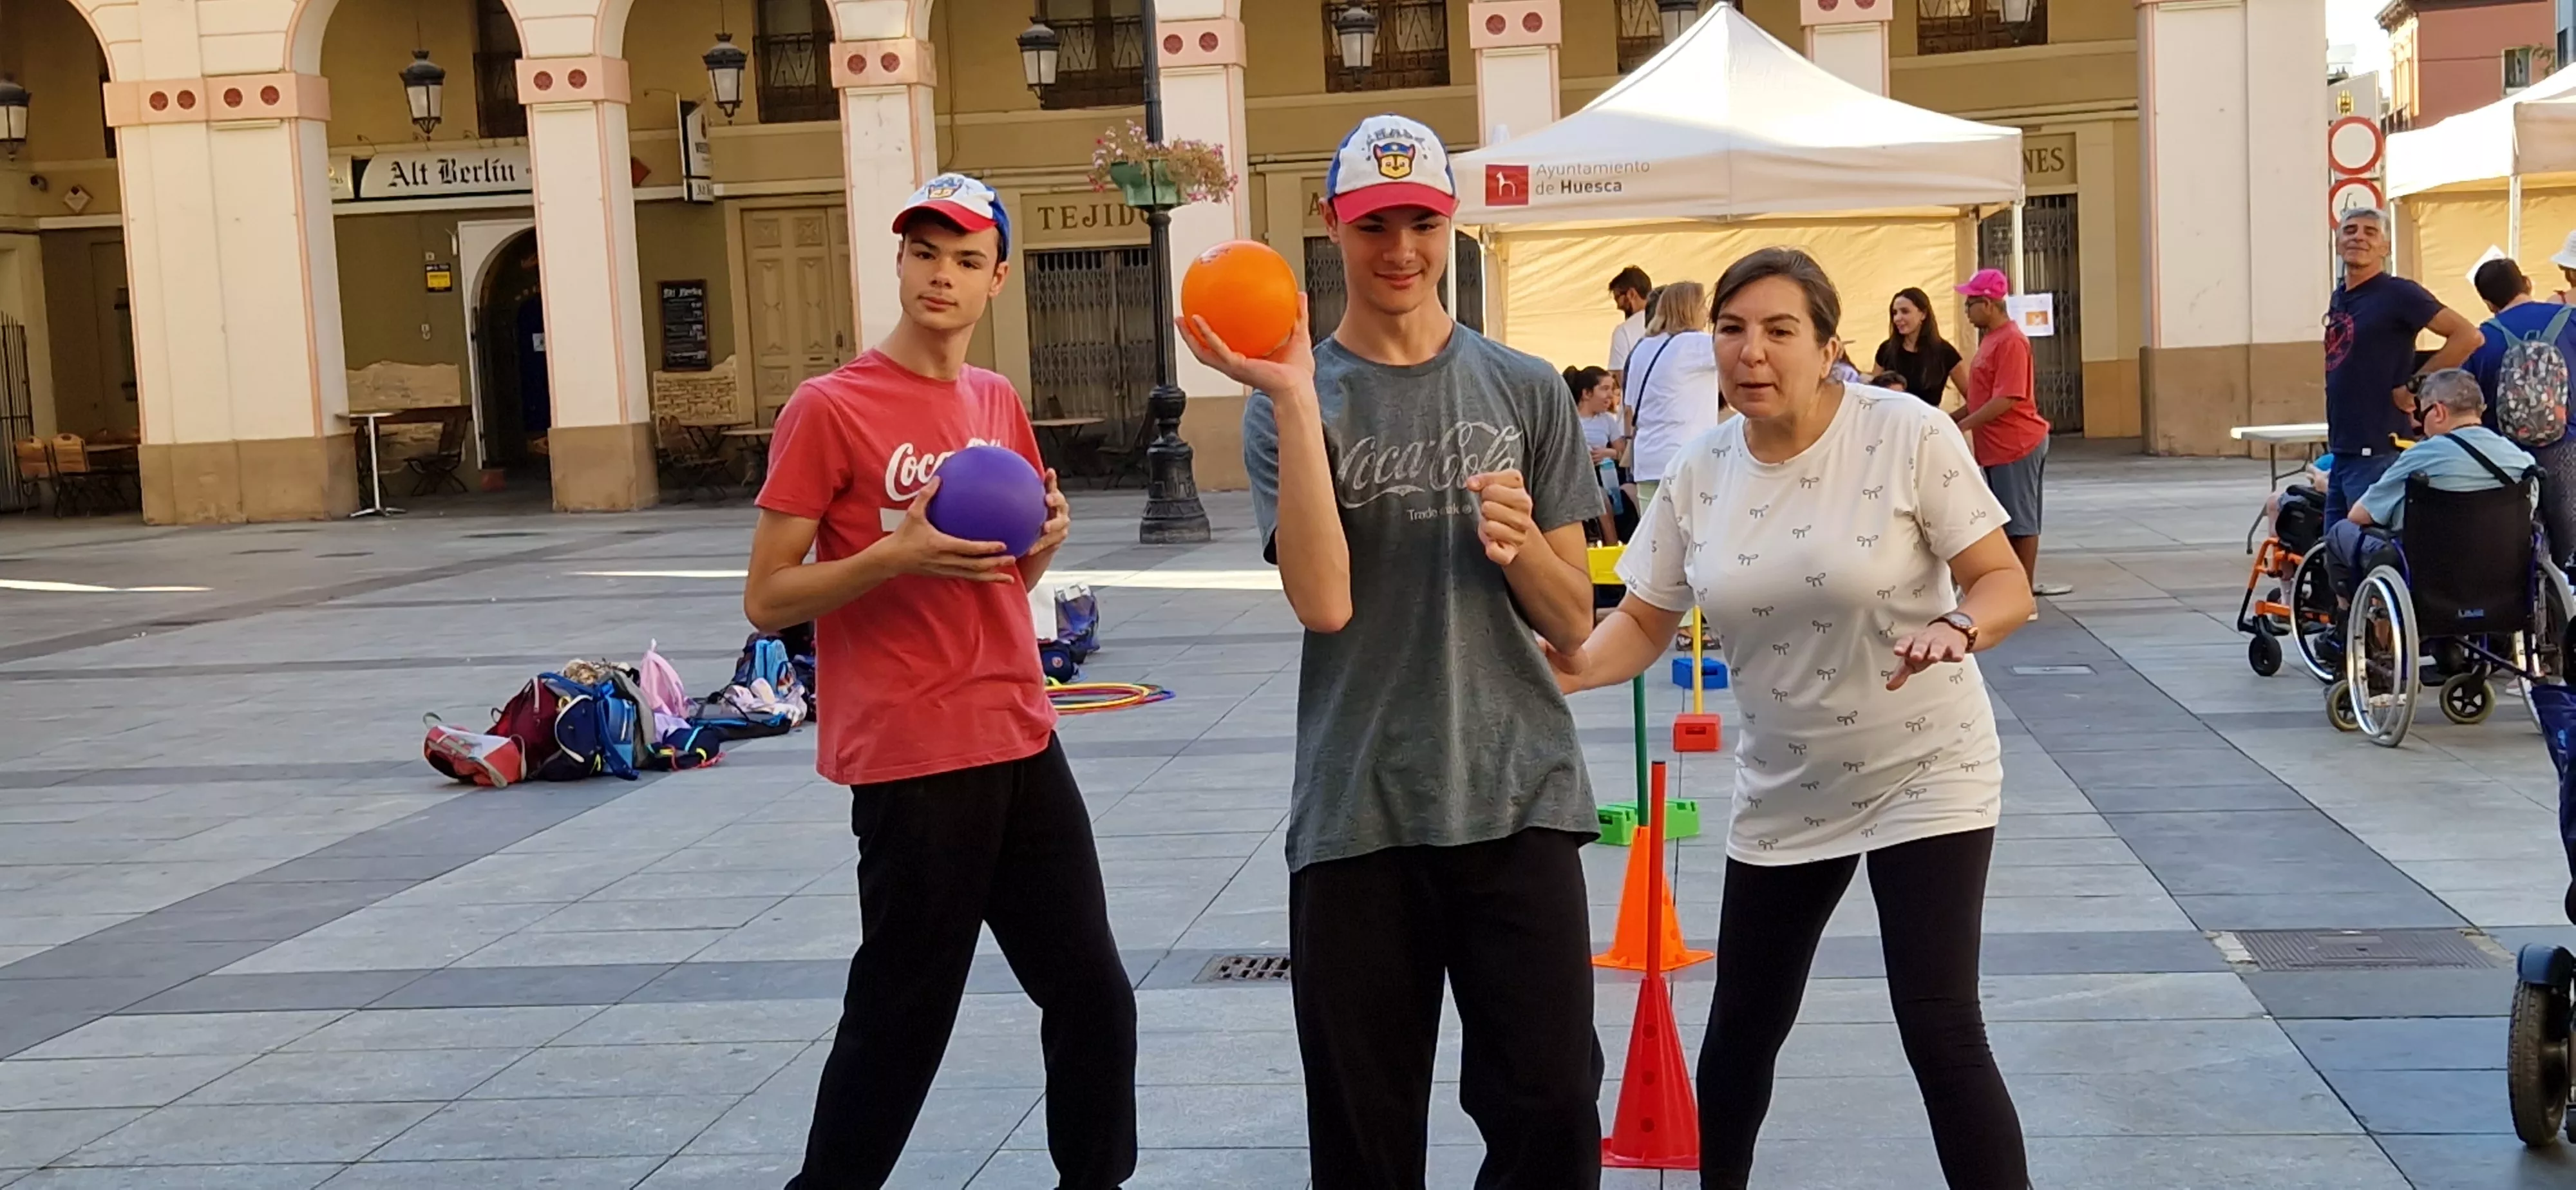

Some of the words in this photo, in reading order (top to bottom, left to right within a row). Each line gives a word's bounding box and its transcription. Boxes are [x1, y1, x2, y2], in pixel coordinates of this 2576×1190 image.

[388, 160, 428, 187] Alt
[1536, 160, 1650, 179] Ayuntamiento
[1535, 181, 1554, 195] de
[1560, 179, 1622, 194] Huesca
